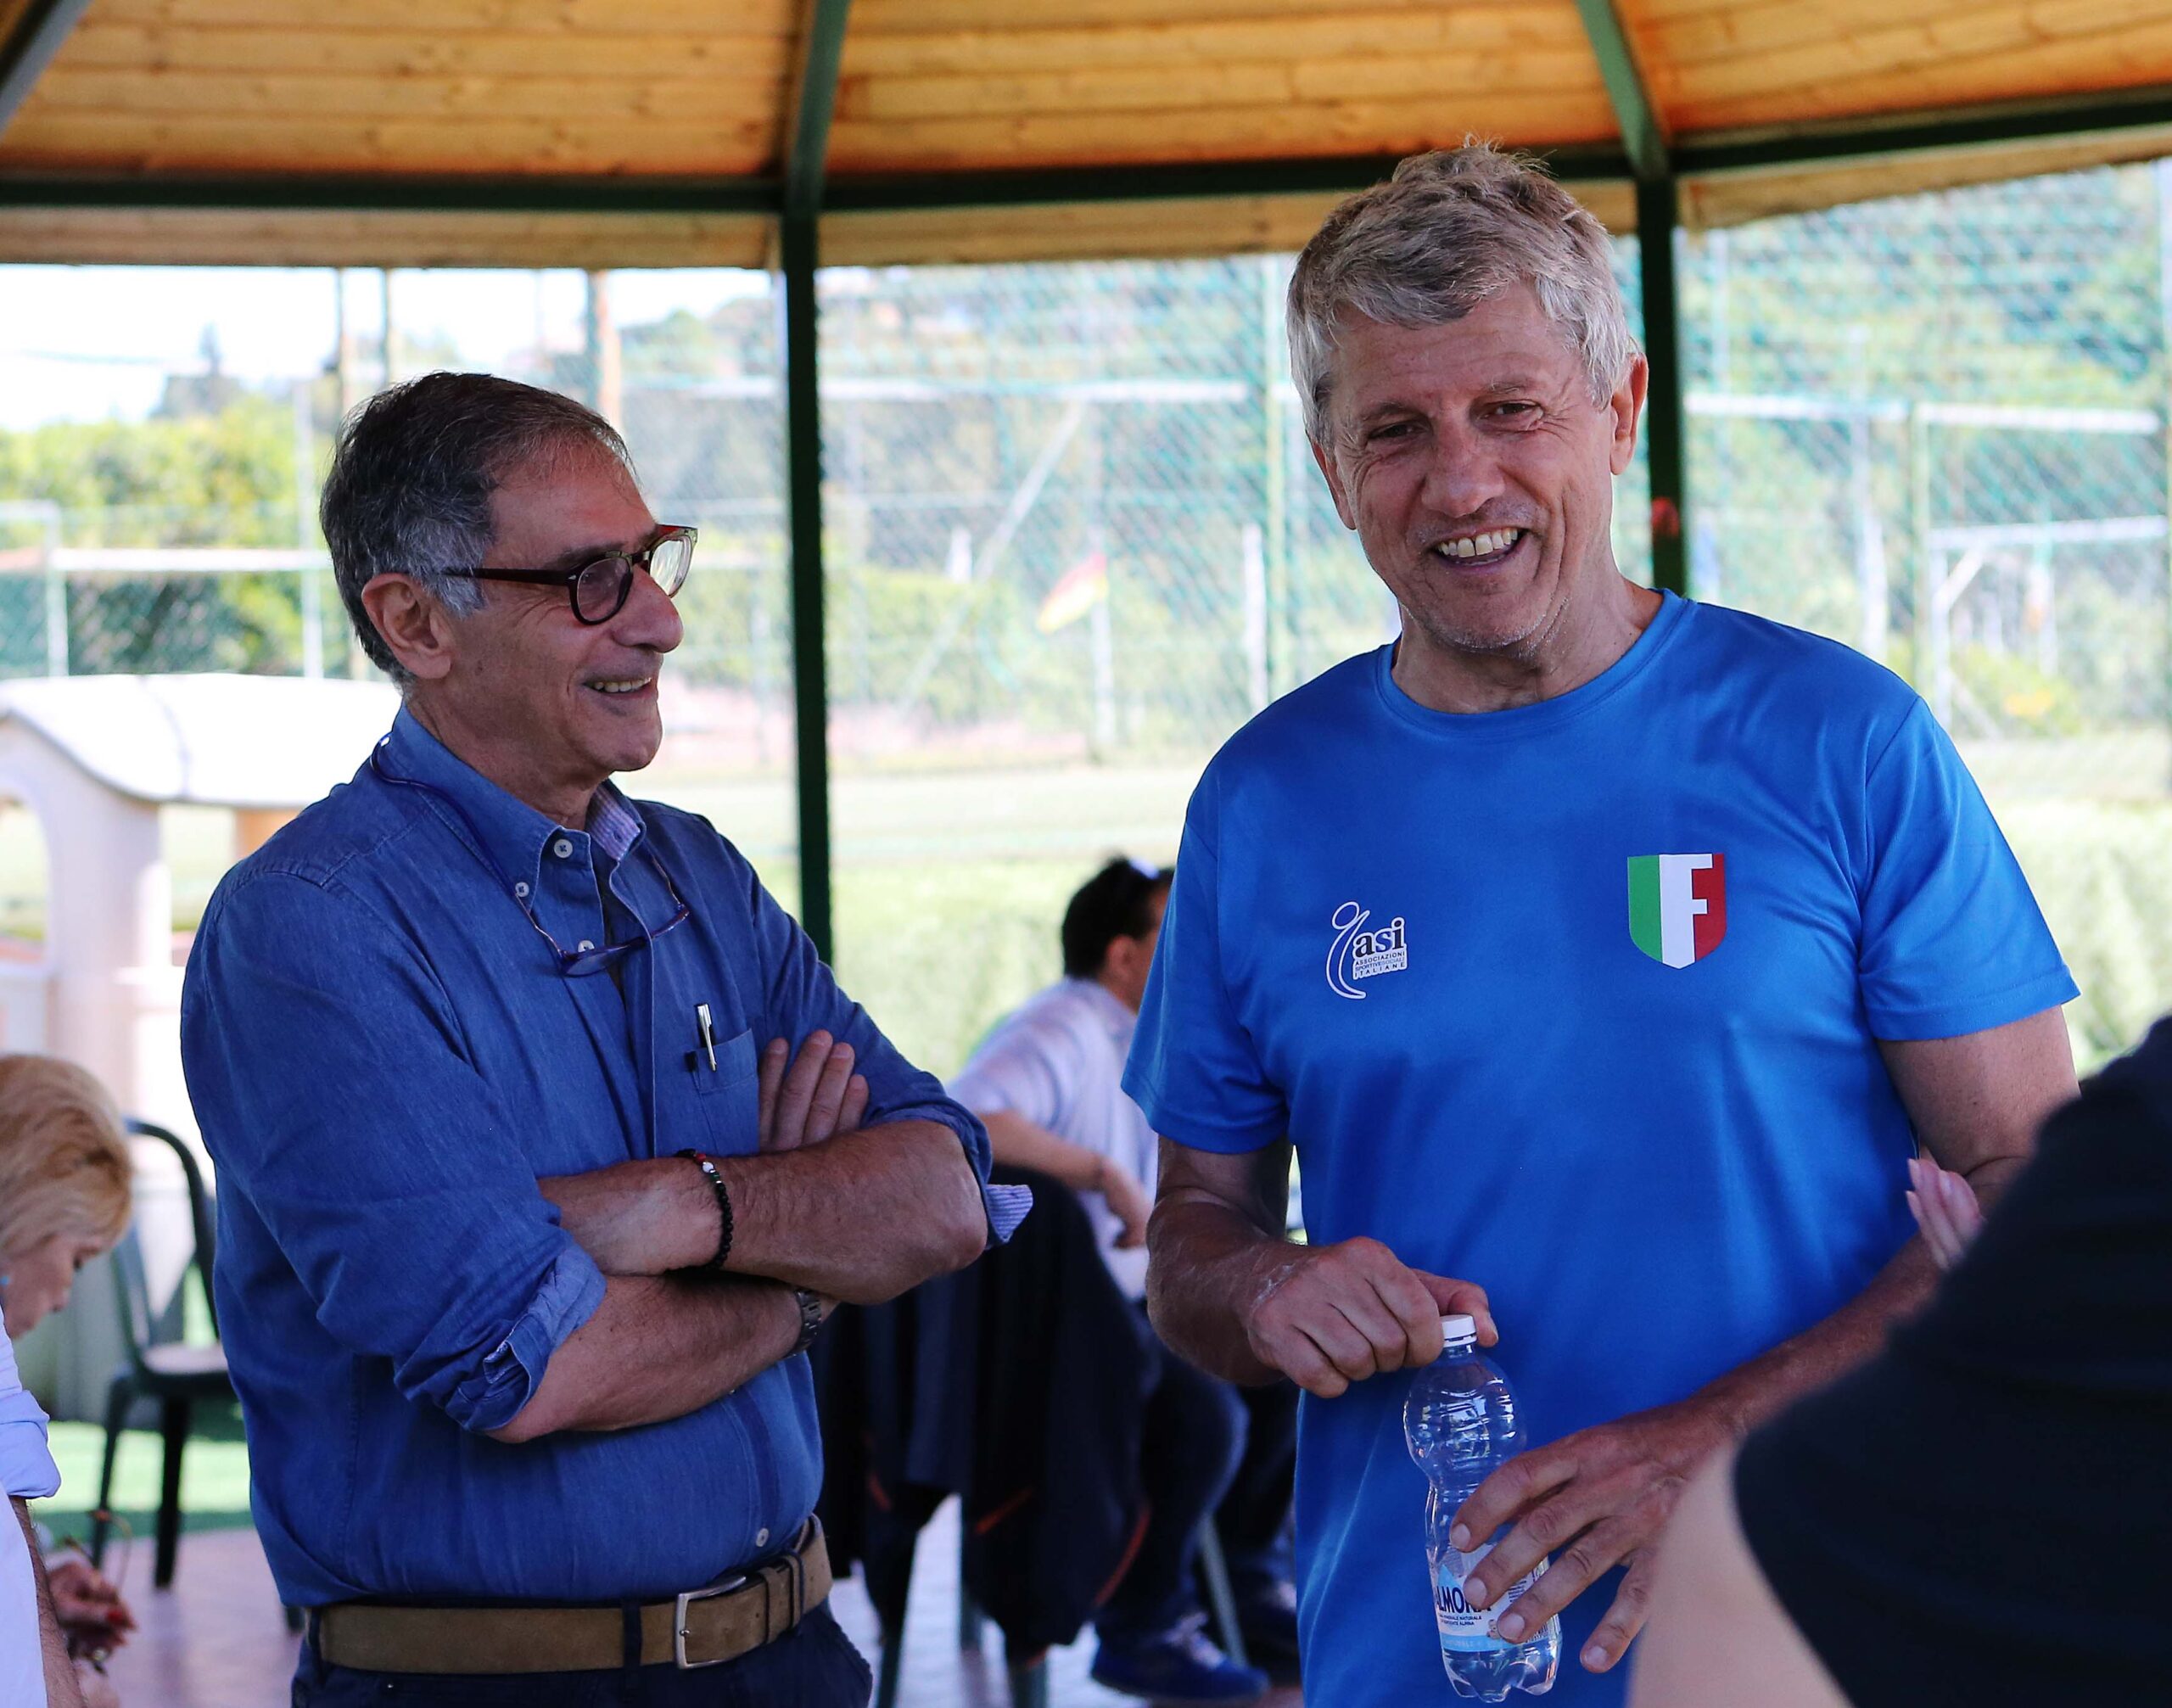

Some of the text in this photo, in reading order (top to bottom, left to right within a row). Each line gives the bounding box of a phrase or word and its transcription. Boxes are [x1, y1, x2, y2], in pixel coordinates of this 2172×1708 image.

[1354, 920, 1405, 958] asi
[1355, 951, 1405, 966] ASSOCIAZIONI
[1354, 961, 1405, 977] ITALIANE
